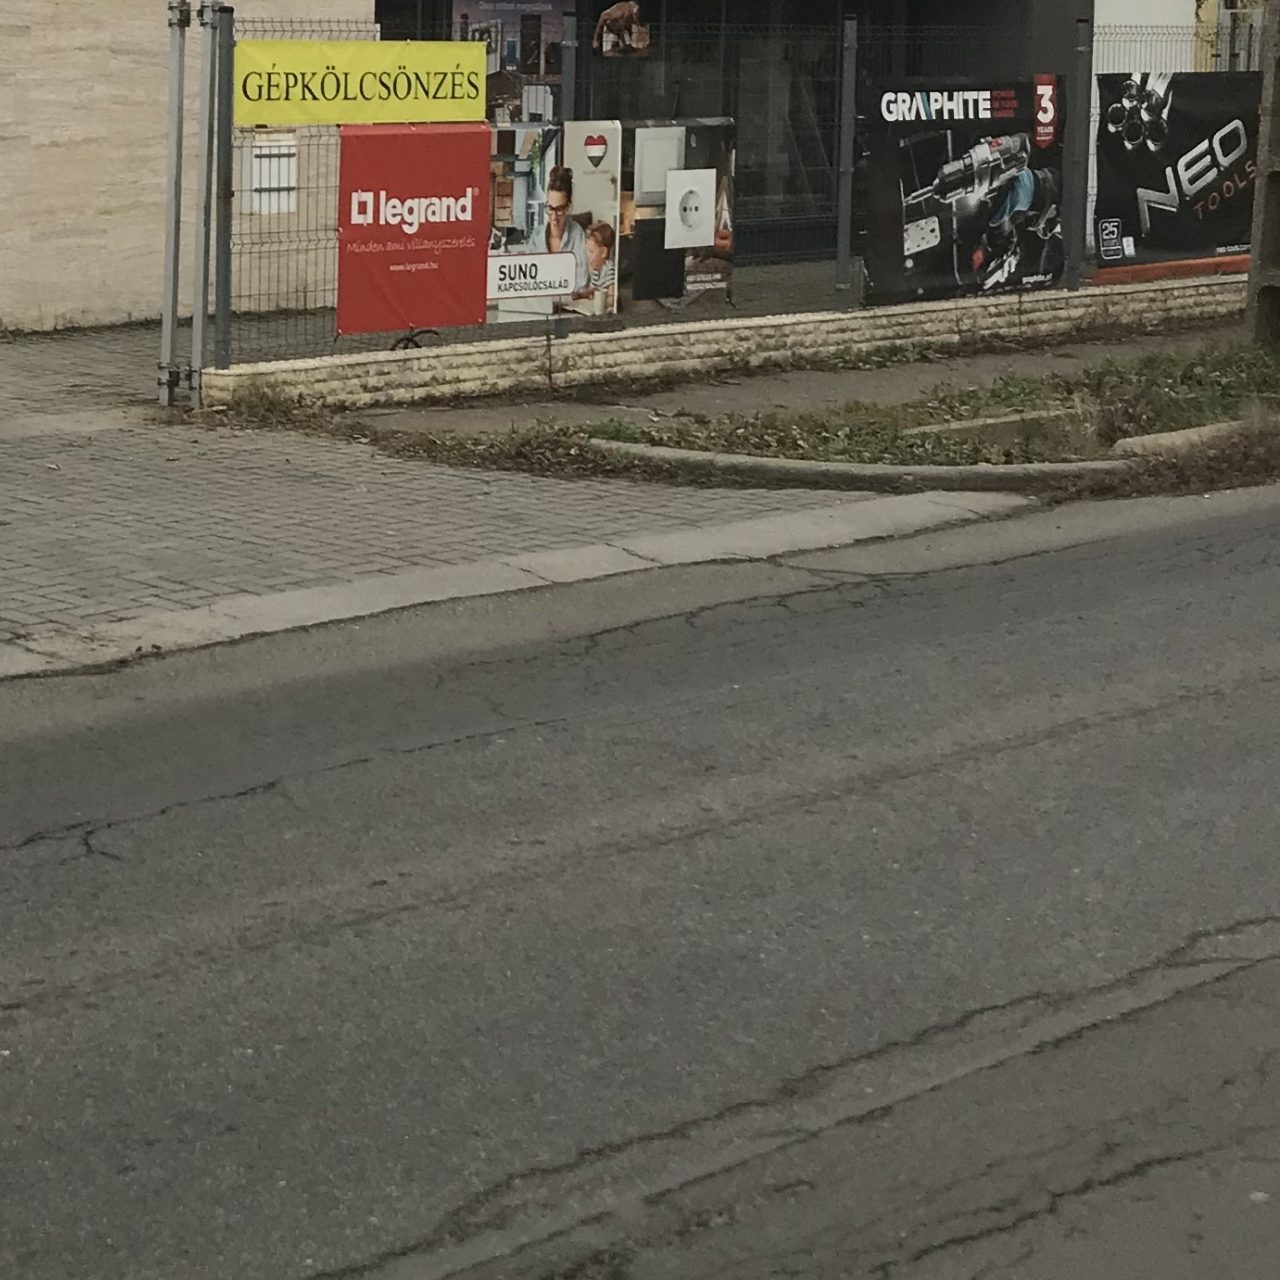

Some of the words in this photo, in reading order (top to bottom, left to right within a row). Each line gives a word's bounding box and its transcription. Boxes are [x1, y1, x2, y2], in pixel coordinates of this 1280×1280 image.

[242, 63, 480, 102] GÉPKÖLCSÖNZÉS
[880, 90, 992, 122] GRAPHITE
[1036, 85, 1055, 124] 3
[1136, 119, 1248, 235] NEO
[1193, 160, 1258, 220] TOOLS
[379, 187, 473, 235] legrand
[1102, 222, 1119, 239] 25
[497, 277, 569, 293] KAPCSOLÓCSALÁD
[498, 263, 538, 282] SUNO
